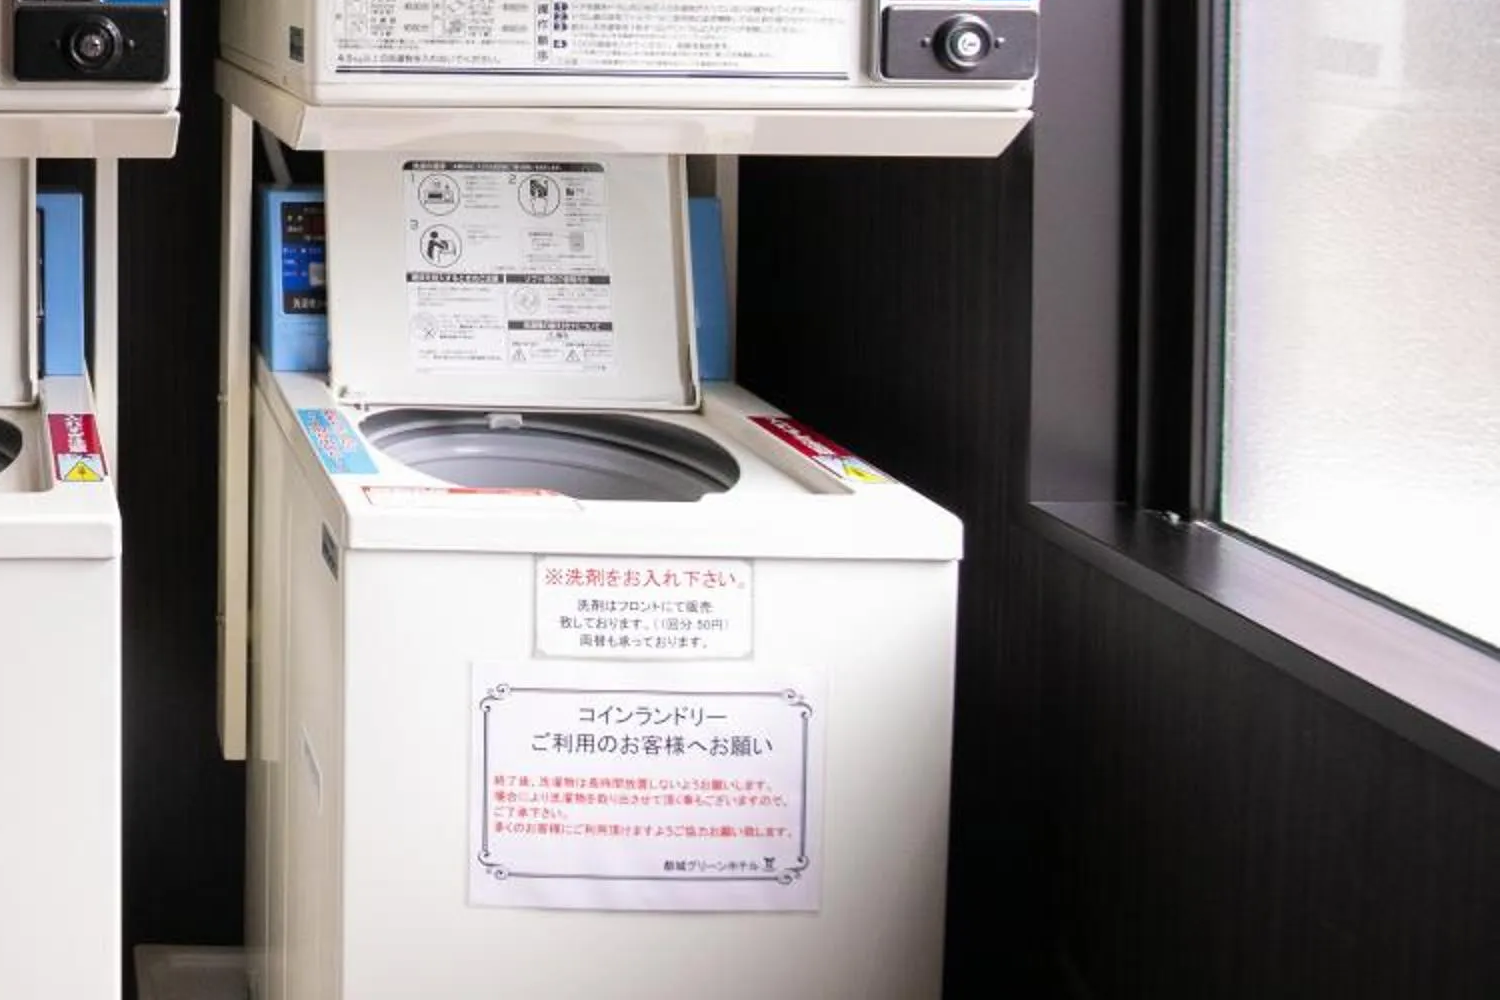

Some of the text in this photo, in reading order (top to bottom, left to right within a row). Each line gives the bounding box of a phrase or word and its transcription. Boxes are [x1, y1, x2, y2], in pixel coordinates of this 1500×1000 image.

[545, 567, 745, 590] ※洗剤をお入れ下さい。
[579, 634, 708, 650] 両替も承っております。
[579, 705, 728, 728] コインランドリー
[530, 732, 774, 758] ご利用のお客様へお願い
